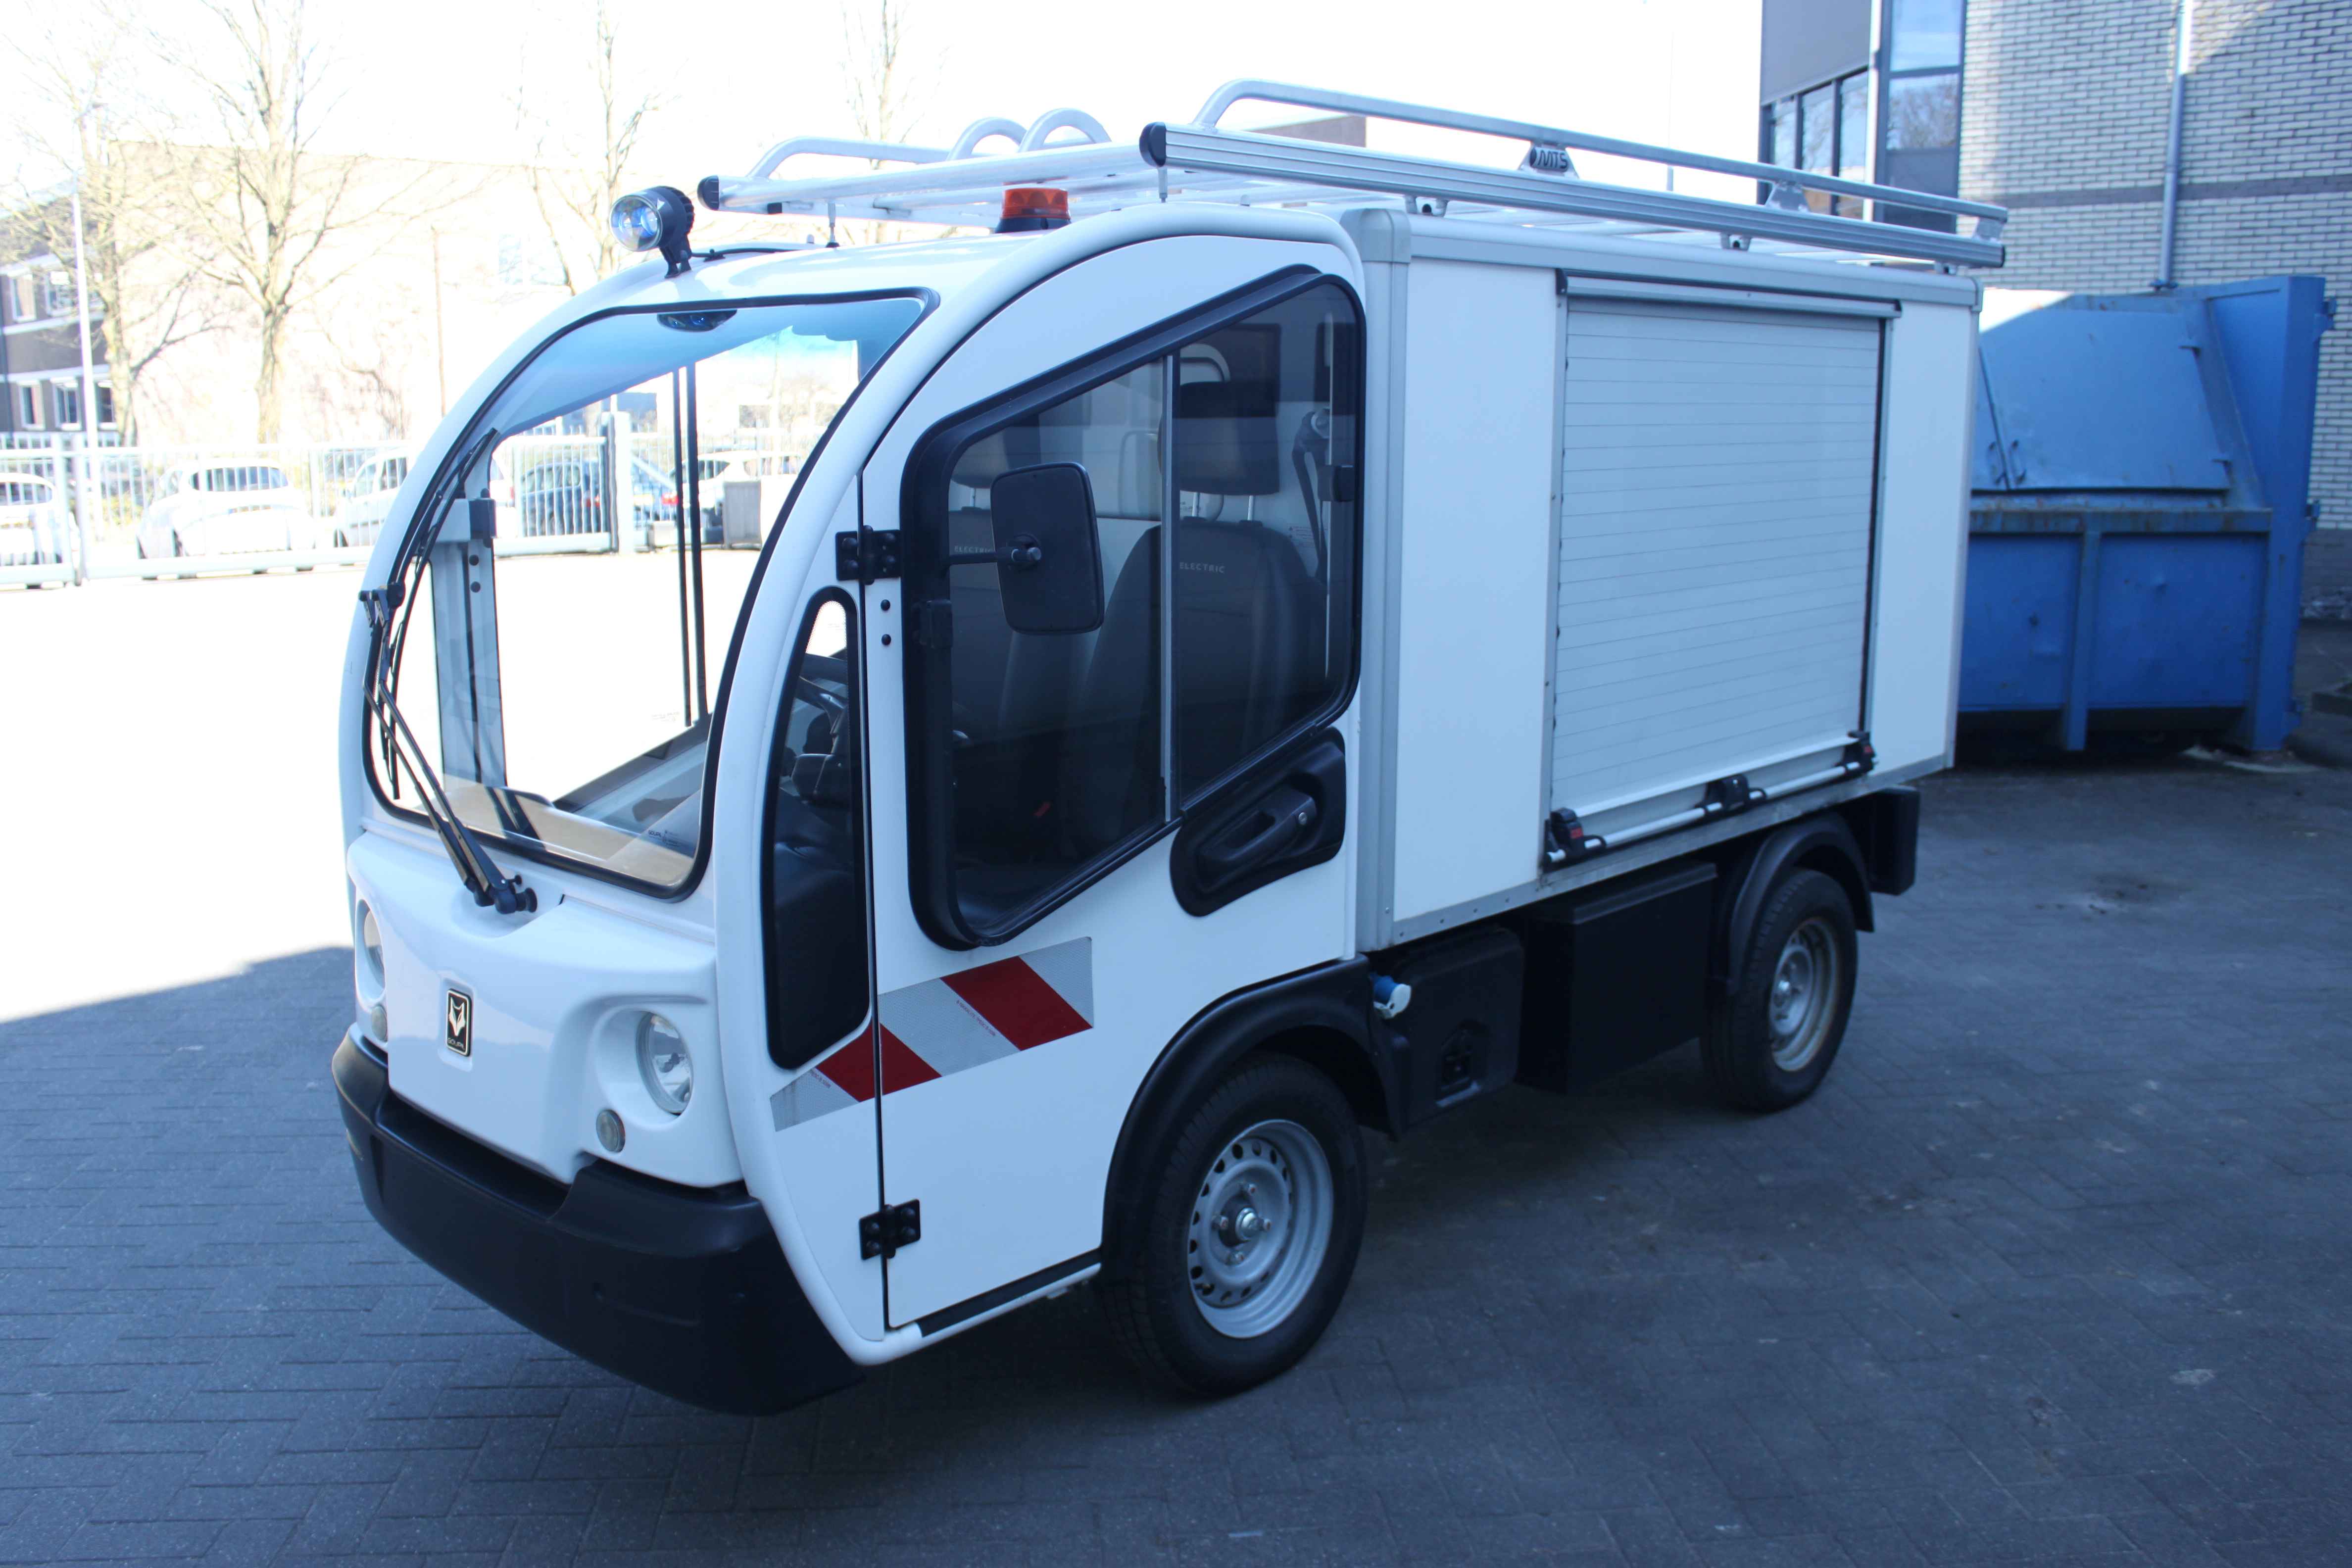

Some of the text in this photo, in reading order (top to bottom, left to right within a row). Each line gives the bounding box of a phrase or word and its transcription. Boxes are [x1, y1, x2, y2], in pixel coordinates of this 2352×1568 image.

[1537, 149, 1568, 169] MTS
[1179, 562, 1225, 574] ELECTRIC
[447, 1037, 465, 1050] GOUPIL
